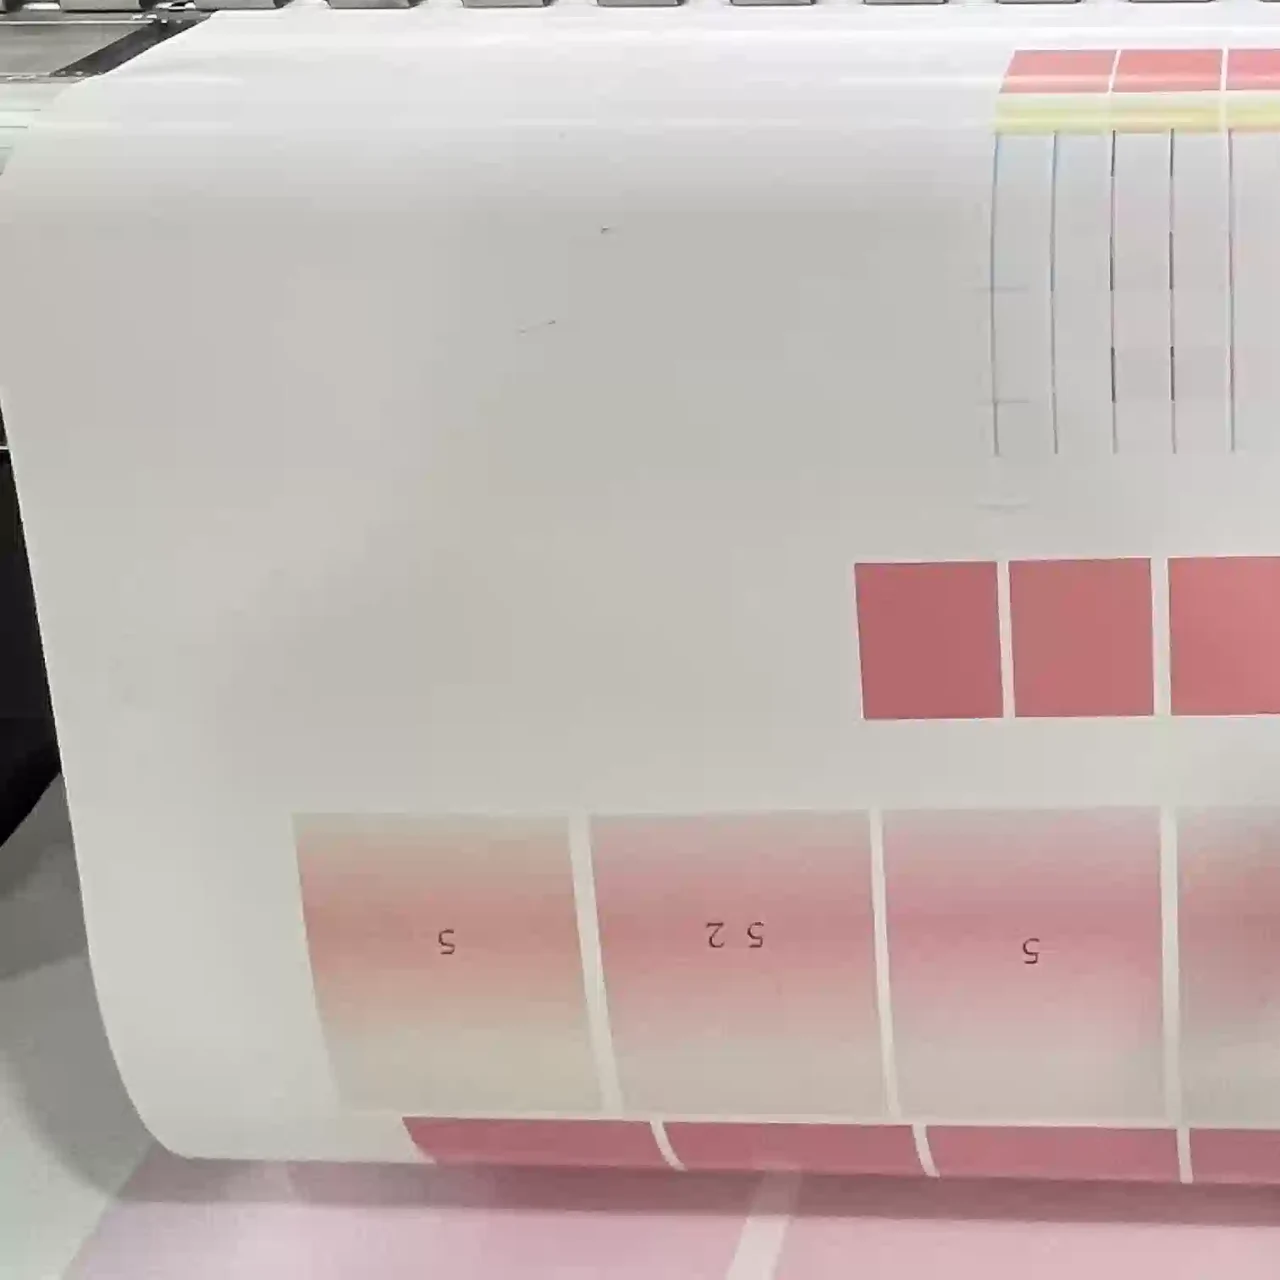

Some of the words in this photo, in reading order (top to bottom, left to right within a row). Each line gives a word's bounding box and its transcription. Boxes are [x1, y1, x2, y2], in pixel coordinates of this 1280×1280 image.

[437, 928, 456, 956] 5
[705, 921, 726, 949] 2
[746, 921, 765, 949] 5
[1022, 937, 1041, 965] 5
